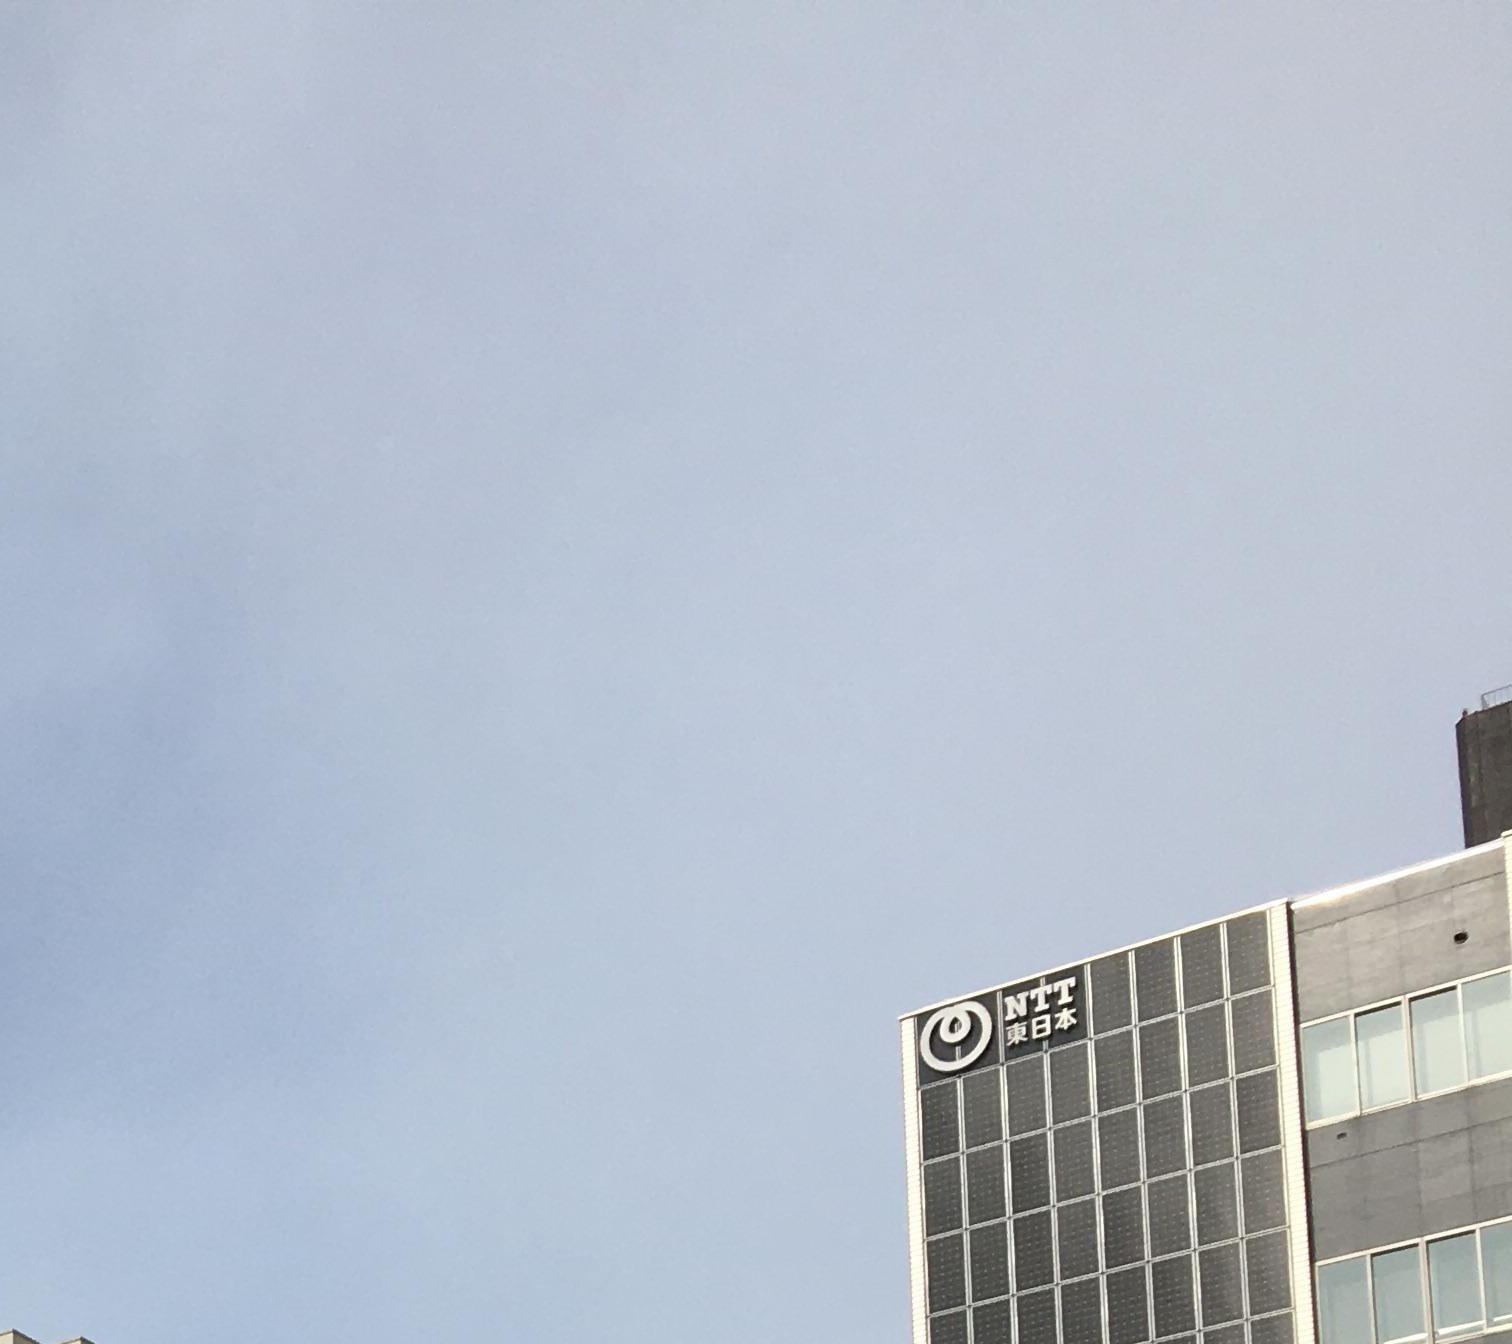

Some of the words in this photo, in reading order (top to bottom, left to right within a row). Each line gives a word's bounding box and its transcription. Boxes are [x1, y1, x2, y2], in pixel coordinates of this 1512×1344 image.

[1004, 976, 1076, 1020] NTT
[1006, 1007, 1077, 1046] 東日本
